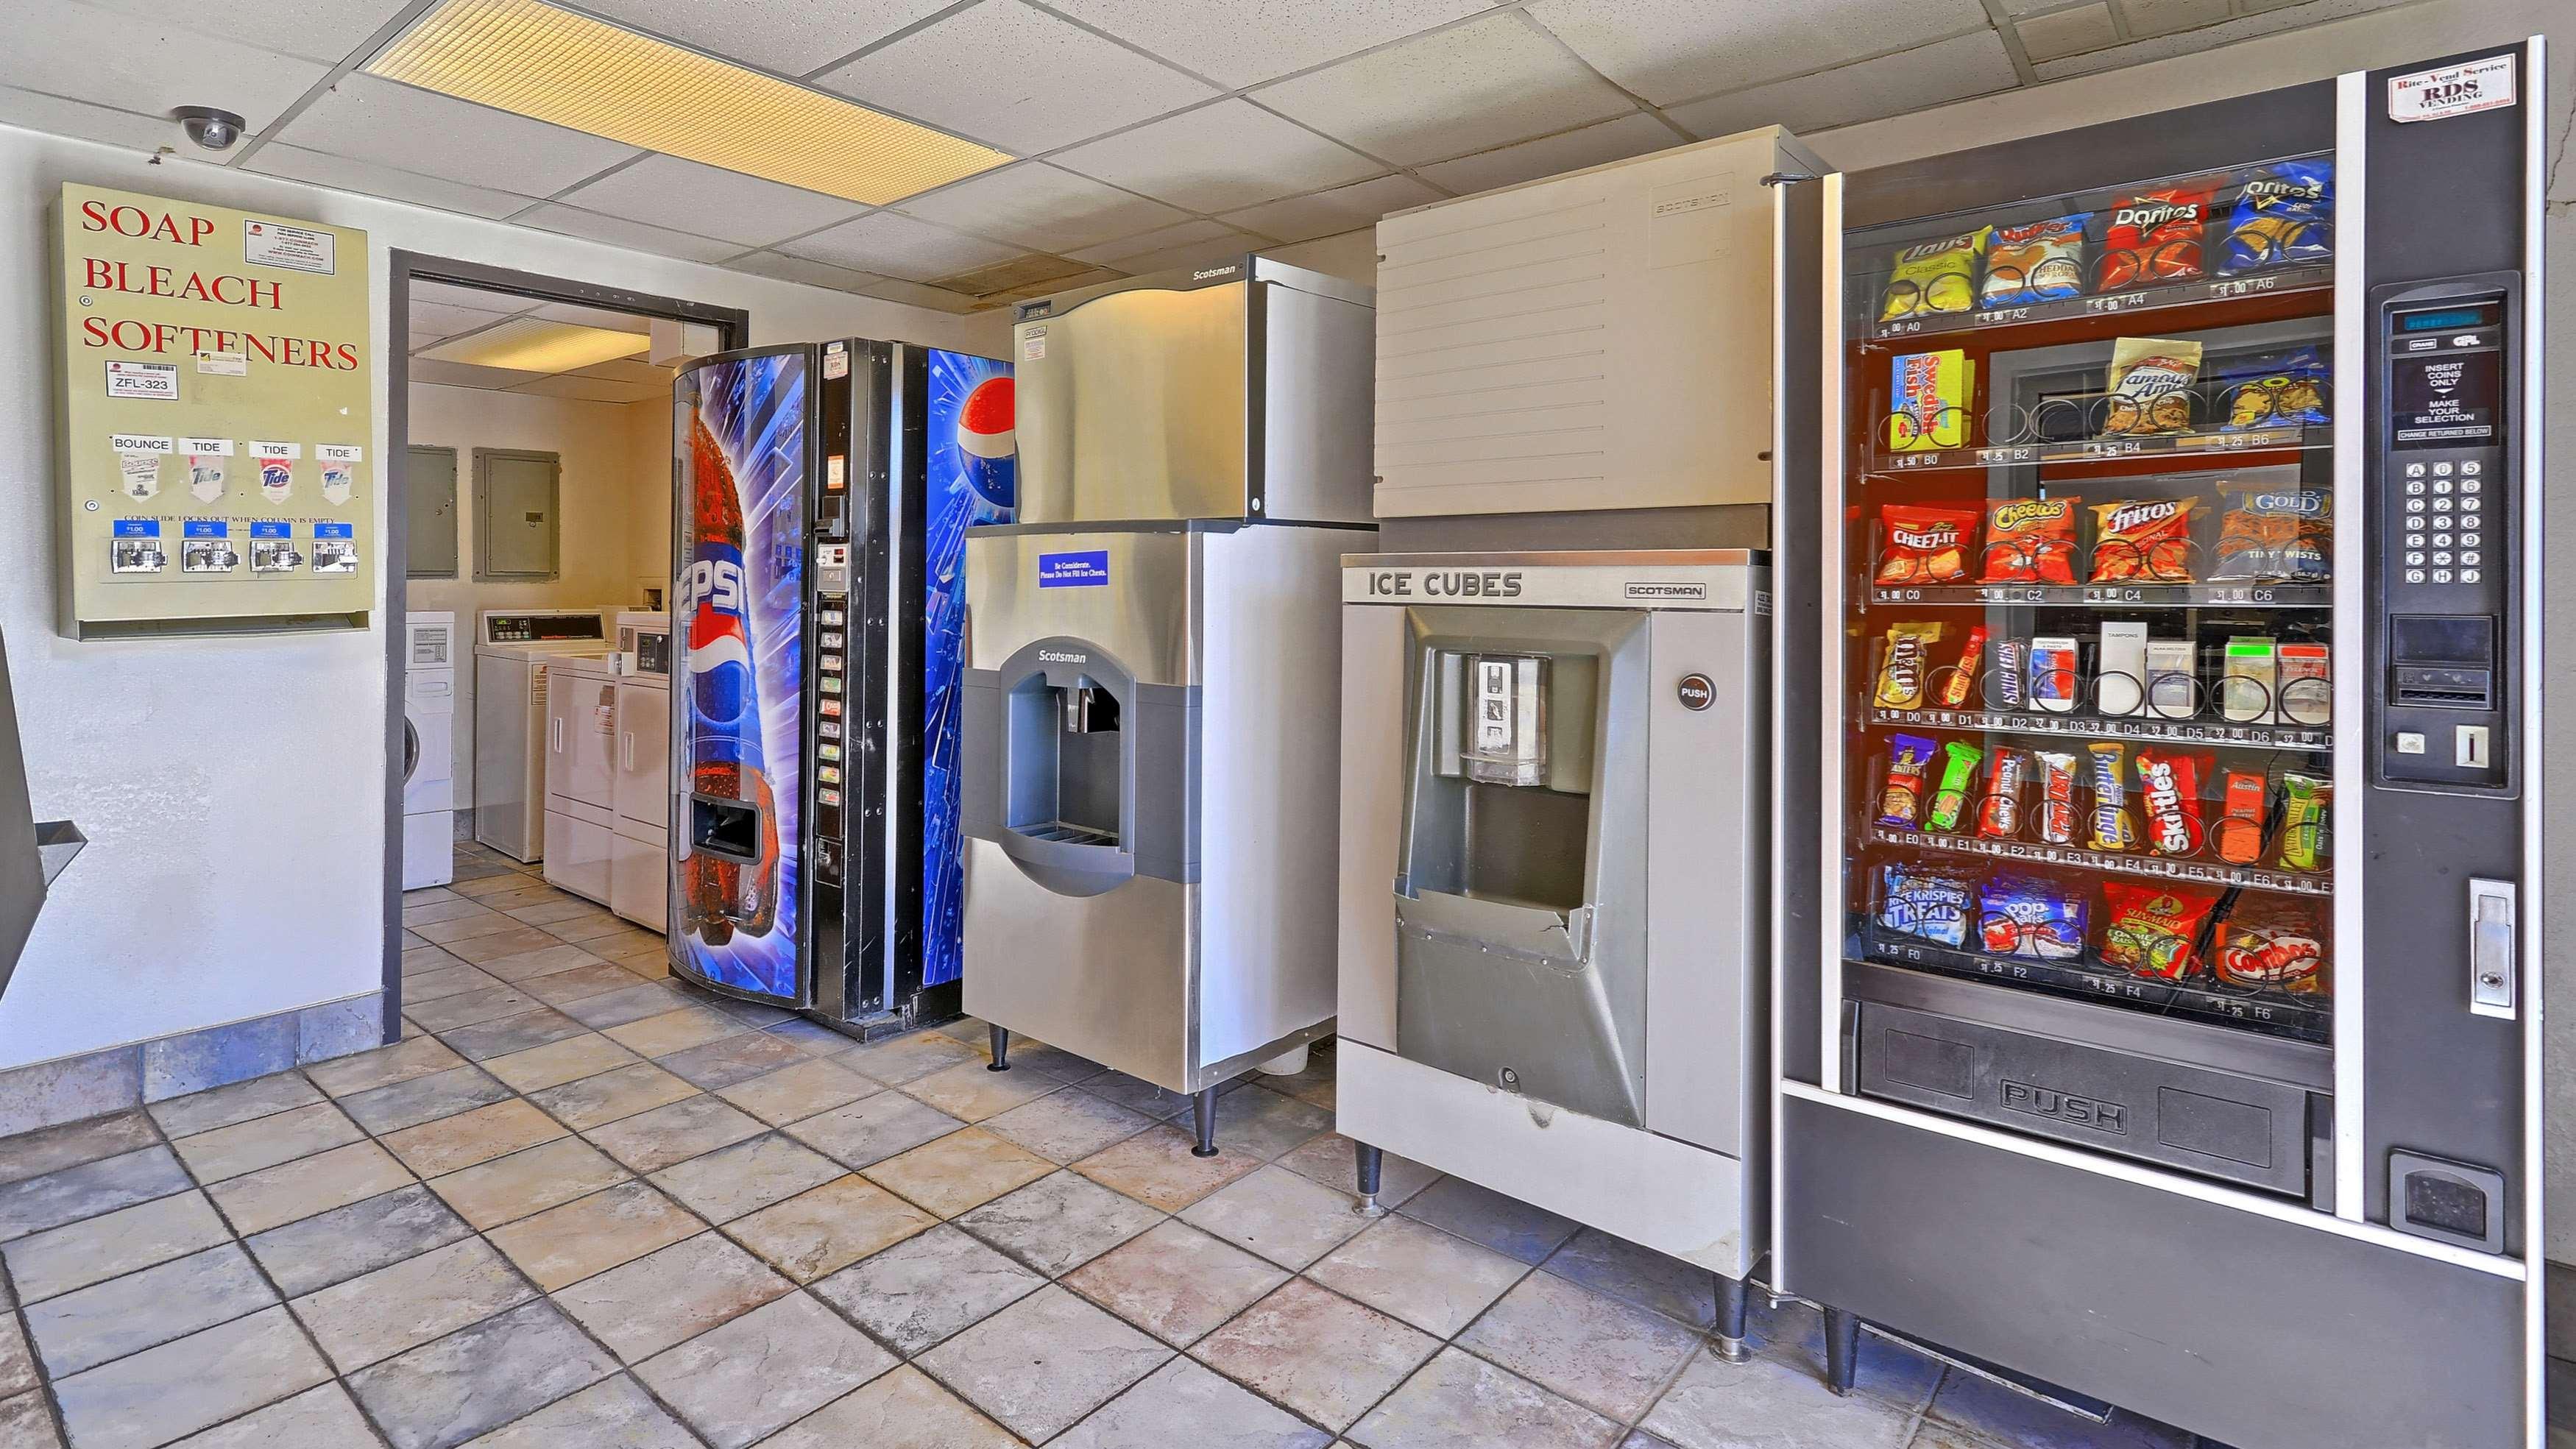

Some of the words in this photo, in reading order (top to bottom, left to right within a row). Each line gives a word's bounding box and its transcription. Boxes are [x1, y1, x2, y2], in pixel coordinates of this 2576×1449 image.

[2398, 80, 2423, 90] Rite
[2430, 72, 2459, 82] Vend
[2463, 63, 2507, 75] Service
[2424, 79, 2479, 101] RDS
[2419, 91, 2483, 108] VENDING
[2115, 203, 2198, 225] Doritos
[82, 200, 214, 247] SOAP
[1194, 266, 1235, 280] Scotsman
[1906, 262, 1956, 275] Classic
[82, 258, 283, 310] BLEACH
[2257, 279, 2274, 289] A6
[2129, 295, 2143, 305] A4
[2013, 309, 2027, 319] A2
[1907, 322, 1919, 331] A0
[82, 316, 359, 371] SOFTENERS
[2425, 363, 2464, 372] INSERT
[1906, 358, 1922, 398] Fish
[2427, 371, 2461, 379] COINS
[115, 378, 168, 390] ZFL-323
[2430, 378, 2458, 387] ONLY
[1922, 356, 1940, 435] Swedish
[2429, 400, 2460, 408] MAKE
[2429, 407, 2460, 415] YOUR
[2415, 414, 2474, 424] SELECTION
[115, 439, 169, 450] BOUNCE
[2252, 434, 2270, 444] B6
[193, 443, 220, 452] TIDE
[262, 446, 289, 455] TIDE
[2125, 442, 2140, 452] B4
[326, 449, 350, 458] TIDE
[2014, 450, 2028, 459] B2
[1924, 455, 1937, 465] B0
[2412, 465, 2421, 475] A
[2467, 464, 2475, 473] 5
[193, 468, 221, 485] Tide
[263, 470, 289, 486] Tide
[324, 471, 350, 489] Tide
[2413, 483, 2421, 493] B
[2441, 483, 2445, 492] 1
[2467, 482, 2475, 492] 6
[2255, 495, 2320, 511] GOLD
[2412, 500, 2420, 511] C
[2439, 500, 2447, 509] 2
[2467, 500, 2474, 509] 7
[1995, 503, 2064, 528] Cheetos
[2413, 519, 2421, 528] D
[2439, 518, 2447, 527] 3
[2466, 518, 2475, 527] 8
[2413, 536, 2420, 546] E
[2439, 536, 2447, 545] 4
[2467, 536, 2475, 545] 9
[2277, 550, 2321, 561] WISTS
[2413, 554, 2420, 563] F
[2412, 572, 2420, 581] G
[2438, 572, 2446, 581] H
[2467, 572, 2473, 581] J
[673, 560, 743, 614] EPSI
[1369, 573, 1412, 596] ICE
[1425, 573, 1522, 598] CUBES
[1627, 584, 1703, 598] SCOTSMAN
[1906, 590, 1919, 600] C0
[2027, 590, 2042, 600] C2
[2126, 590, 2142, 600] C4
[2255, 590, 2272, 600] C6
[1038, 650, 1086, 664] Scotsman
[1681, 687, 1708, 699] PUSH
[1907, 712, 1920, 722] D0
[1959, 715, 1971, 725] D1
[2012, 718, 2027, 728] D2
[2070, 721, 2085, 731] D3
[2124, 724, 2140, 734] D4
[2187, 729, 2204, 739] D5
[2252, 731, 2270, 742] D6
[2000, 759, 2016, 793] Peanut
[2232, 782, 2261, 792] Austin
[2092, 751, 2118, 843] Butteringe
[2151, 762, 2189, 851] Skittles
[1998, 796, 2014, 829] Chews
[1906, 835, 1918, 844] E0
[2285, 823, 2299, 854] NATUR
[2315, 835, 2324, 849] Oats
[1958, 840, 1970, 850] E1
[2011, 846, 2024, 855] E2
[2067, 853, 2081, 863] E3
[2126, 859, 2140, 870] E4
[2189, 867, 2204, 878] E5
[2254, 875, 2270, 886] E6
[1914, 890, 1965, 904] KRISPIES
[1889, 901, 1961, 927] TREATS
[1909, 949, 1919, 960] F0
[2014, 968, 2027, 978] F2
[2127, 986, 2140, 998] F4
[2256, 1007, 2271, 1018] F6
[2005, 1085, 2123, 1131] PUSH
